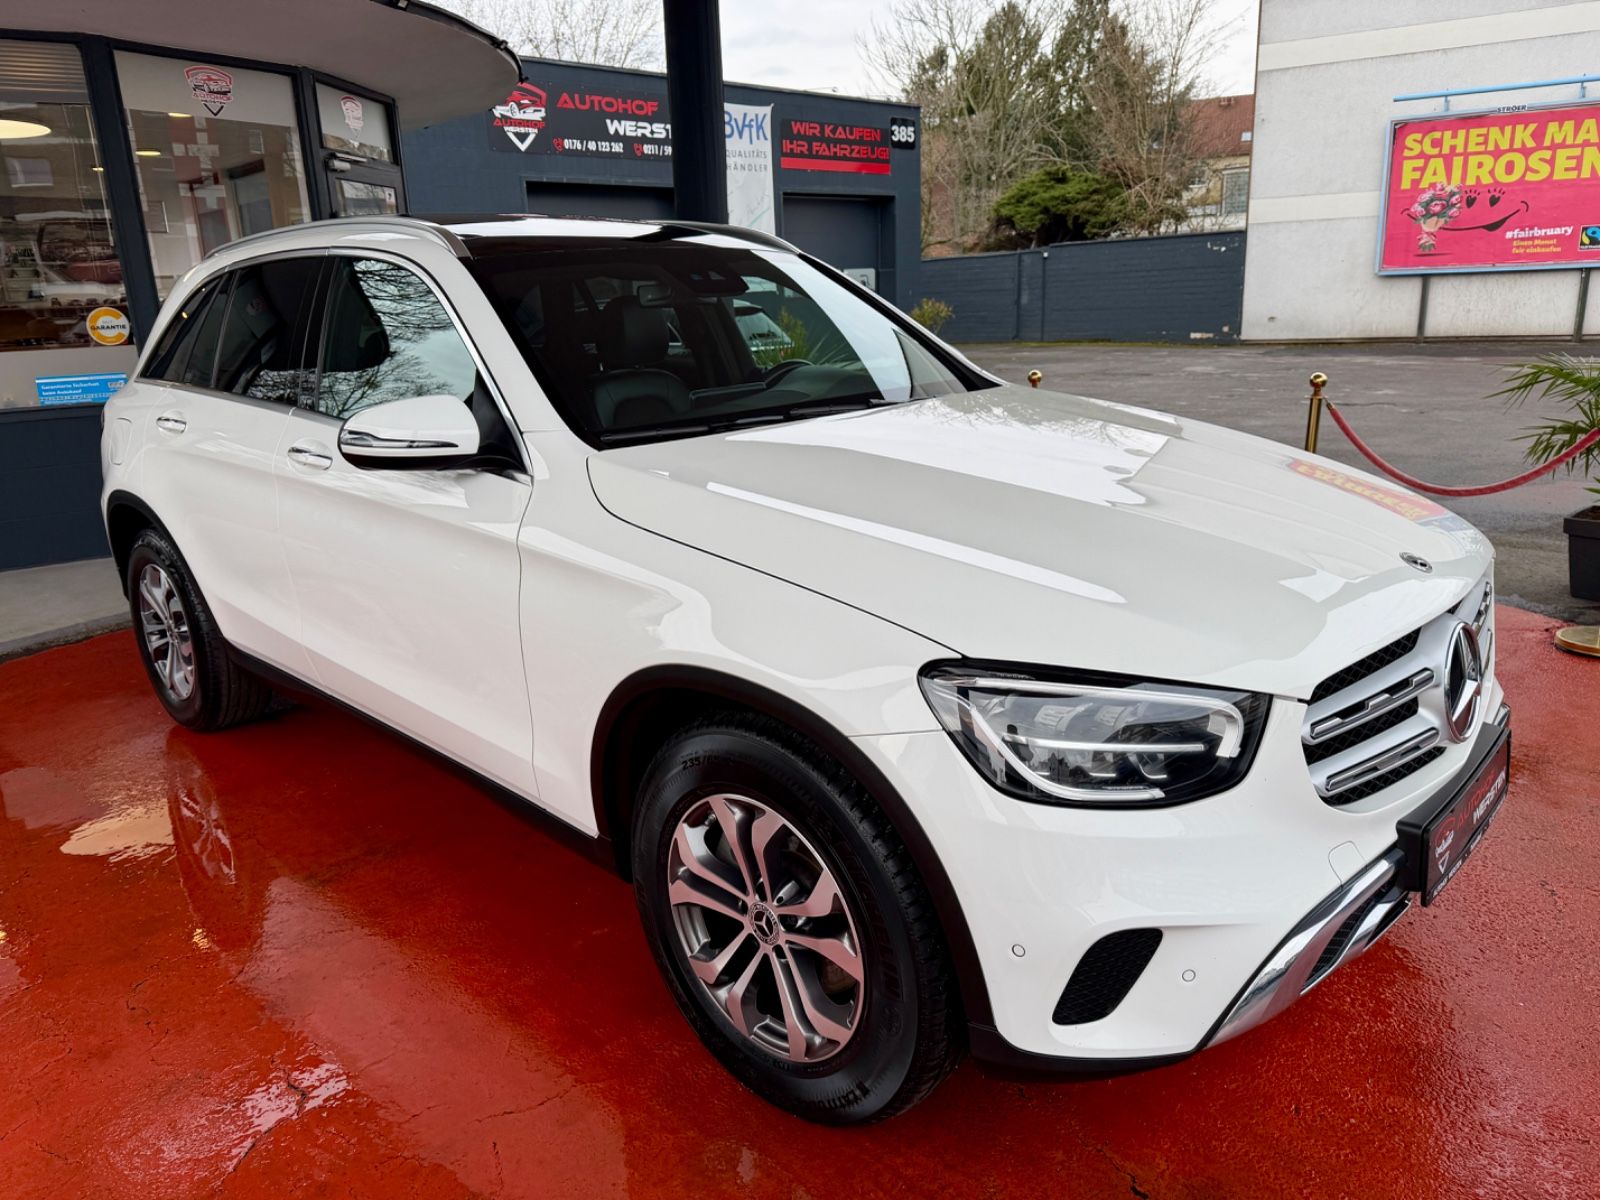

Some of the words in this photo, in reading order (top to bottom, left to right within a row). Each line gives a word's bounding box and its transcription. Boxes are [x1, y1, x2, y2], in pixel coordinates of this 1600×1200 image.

[557, 92, 659, 116] AUTOHOF
[493, 118, 545, 129] AUTOHOF
[724, 111, 768, 145] BVfK
[791, 121, 821, 138] WIR
[824, 124, 881, 142] KAUFEN
[891, 125, 915, 143] 385
[1402, 122, 1539, 157] SCHENK
[564, 138, 582, 150] 0176
[587, 140, 597, 151] 40
[598, 141, 610, 152] 123
[611, 142, 624, 153] 262
[643, 144, 658, 155] 0211
[782, 139, 808, 155] IHR
[1401, 146, 1600, 190] FAIROSEN
[1505, 225, 1574, 239] #fairbruary
